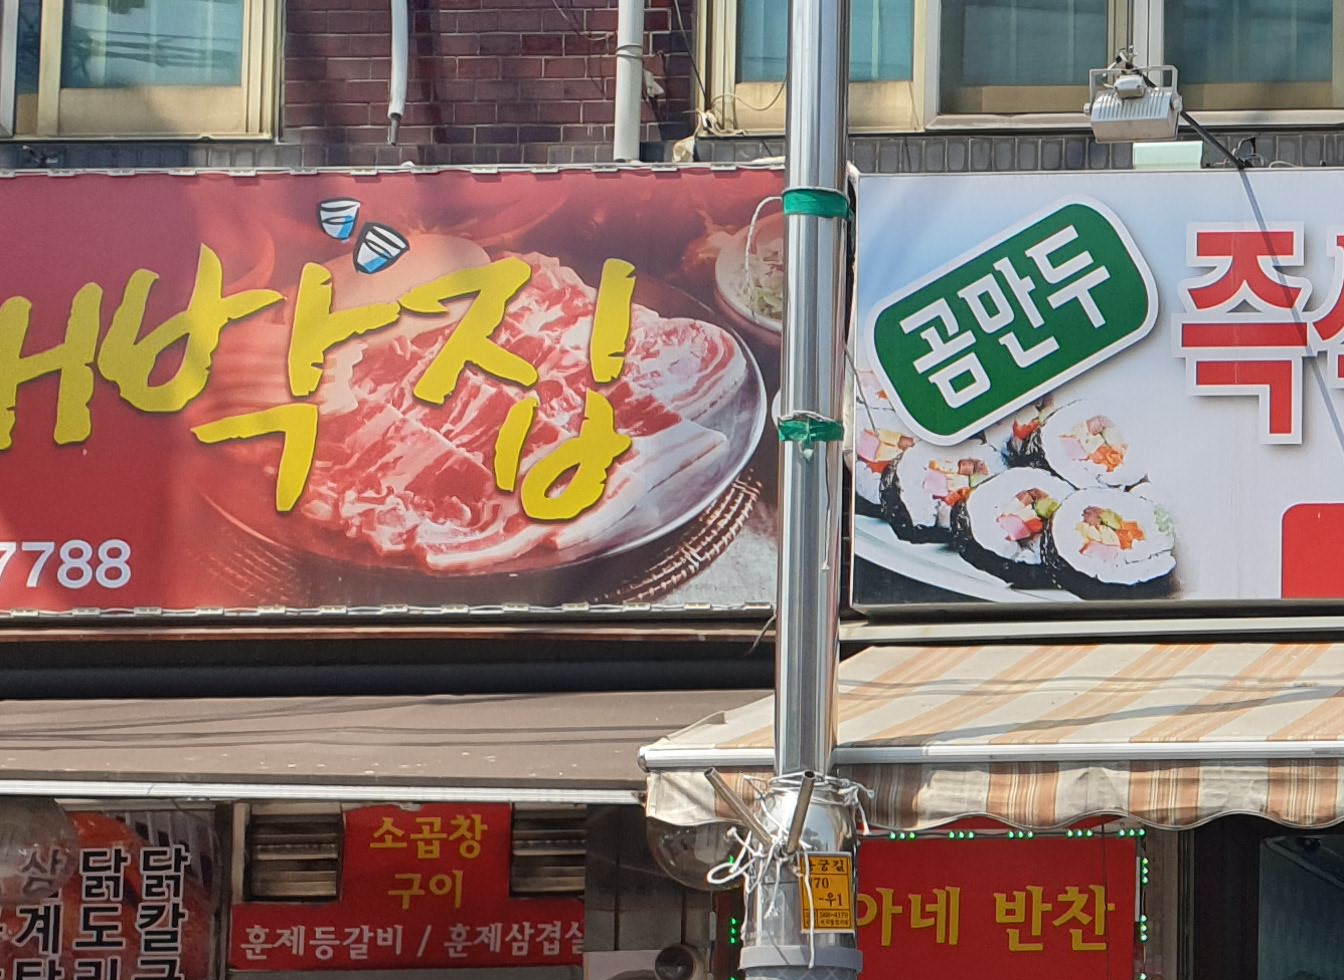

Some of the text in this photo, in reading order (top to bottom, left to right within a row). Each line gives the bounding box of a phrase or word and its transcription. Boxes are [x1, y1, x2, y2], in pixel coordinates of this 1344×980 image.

[898, 222, 1109, 408] 곰만두
[370, 815, 488, 859] 소곱창
[388, 870, 464, 910] 구이
[995, 885, 1115, 952] 반찬
[241, 925, 402, 960] 훈제등갈비
